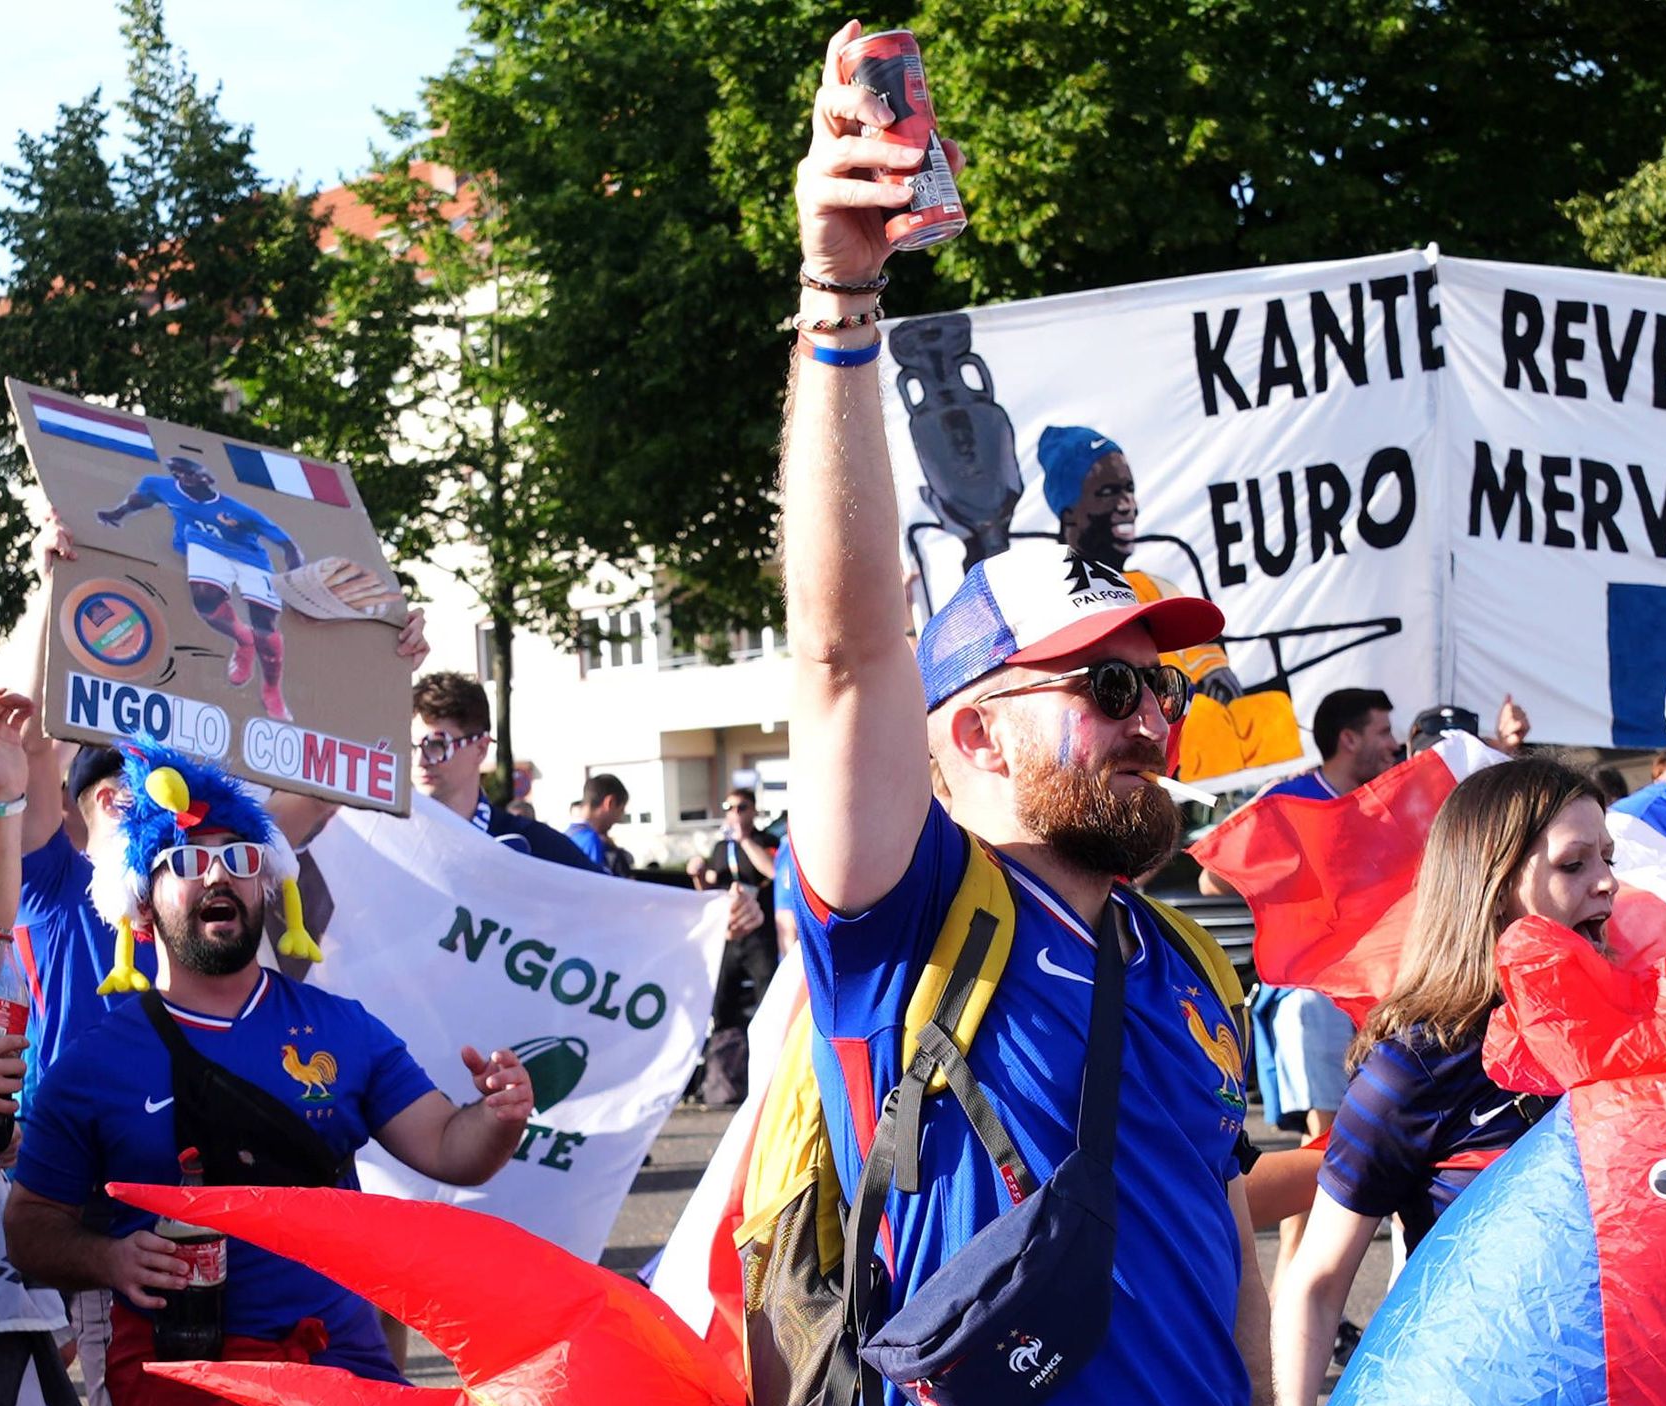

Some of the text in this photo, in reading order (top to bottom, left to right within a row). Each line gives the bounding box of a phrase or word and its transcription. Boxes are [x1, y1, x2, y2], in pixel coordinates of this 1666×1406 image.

[1193, 269, 1446, 417] KANTE
[1208, 446, 1417, 588] EURO
[70, 675, 394, 801] N'GOLO COMTÉ
[438, 905, 667, 1030] N'GOLO
[1029, 1352, 1063, 1389] FRANCE
